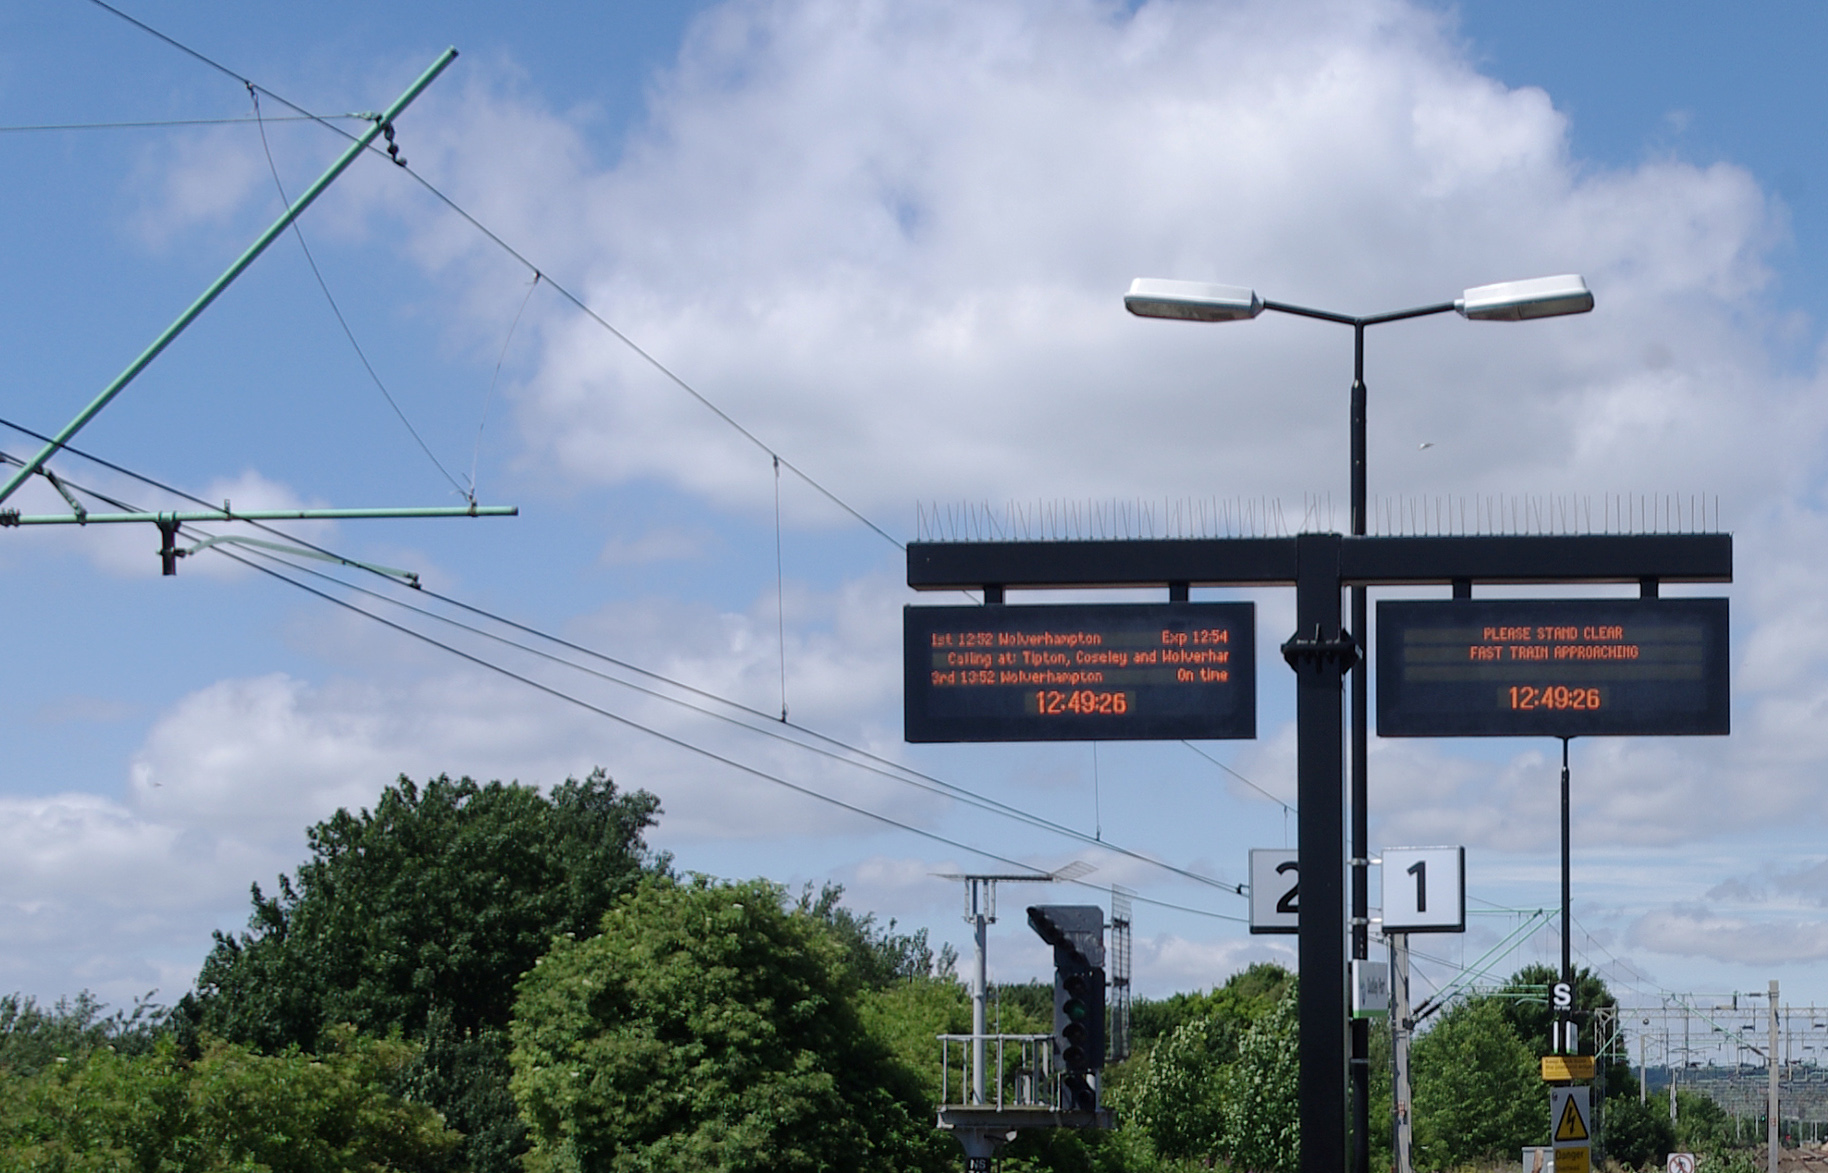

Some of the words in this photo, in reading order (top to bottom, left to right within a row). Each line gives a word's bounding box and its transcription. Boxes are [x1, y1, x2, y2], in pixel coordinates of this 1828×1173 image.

[932, 632, 953, 647] 1st
[997, 631, 1102, 648] Wolverhampton
[1161, 629, 1188, 647] Exp
[1193, 629, 1228, 644] 12:54
[1483, 627, 1531, 641] PLEASE
[1537, 627, 1578, 640] STAND
[1583, 626, 1623, 640] CLEAR
[947, 651, 993, 669] Calling
[997, 651, 1017, 664] at:
[1022, 650, 1071, 667] Tipton,
[1076, 650, 1128, 667] Coseley
[1133, 649, 1157, 664] and
[1469, 646, 1503, 660] FAST
[1510, 646, 1549, 660] TRAIN
[1554, 645, 1639, 660] APPROACHING
[1000, 669, 1103, 686] Wolverhampton
[1177, 667, 1194, 682] On
[1200, 667, 1228, 682] time
[1036, 690, 1127, 714] 12:49:26
[1509, 686, 1600, 710] 12:49:26
[1275, 860, 1299, 913] 2
[1406, 860, 1426, 912] 1
[1553, 982, 1571, 1006] S
